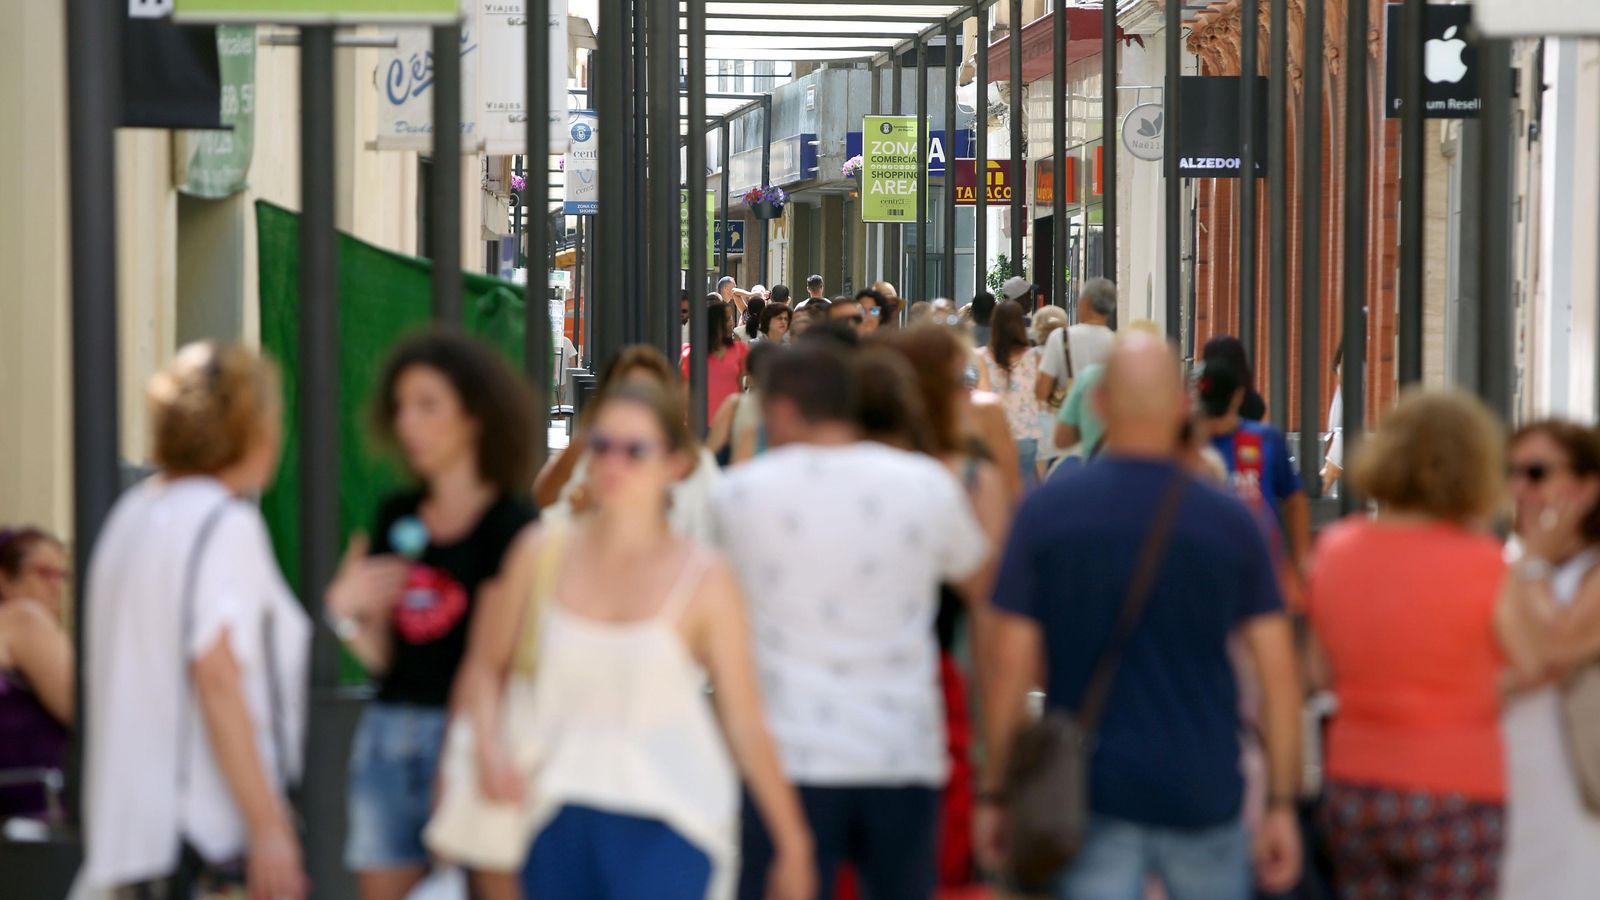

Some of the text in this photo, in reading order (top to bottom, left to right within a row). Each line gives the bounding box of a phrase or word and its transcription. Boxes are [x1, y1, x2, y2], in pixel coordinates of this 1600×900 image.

[485, 4, 520, 12] VIAJES
[486, 102, 521, 110] VIAJES
[871, 141, 918, 155] ZONA
[870, 179, 918, 195] AREA
[956, 186, 1012, 199] TAACO
